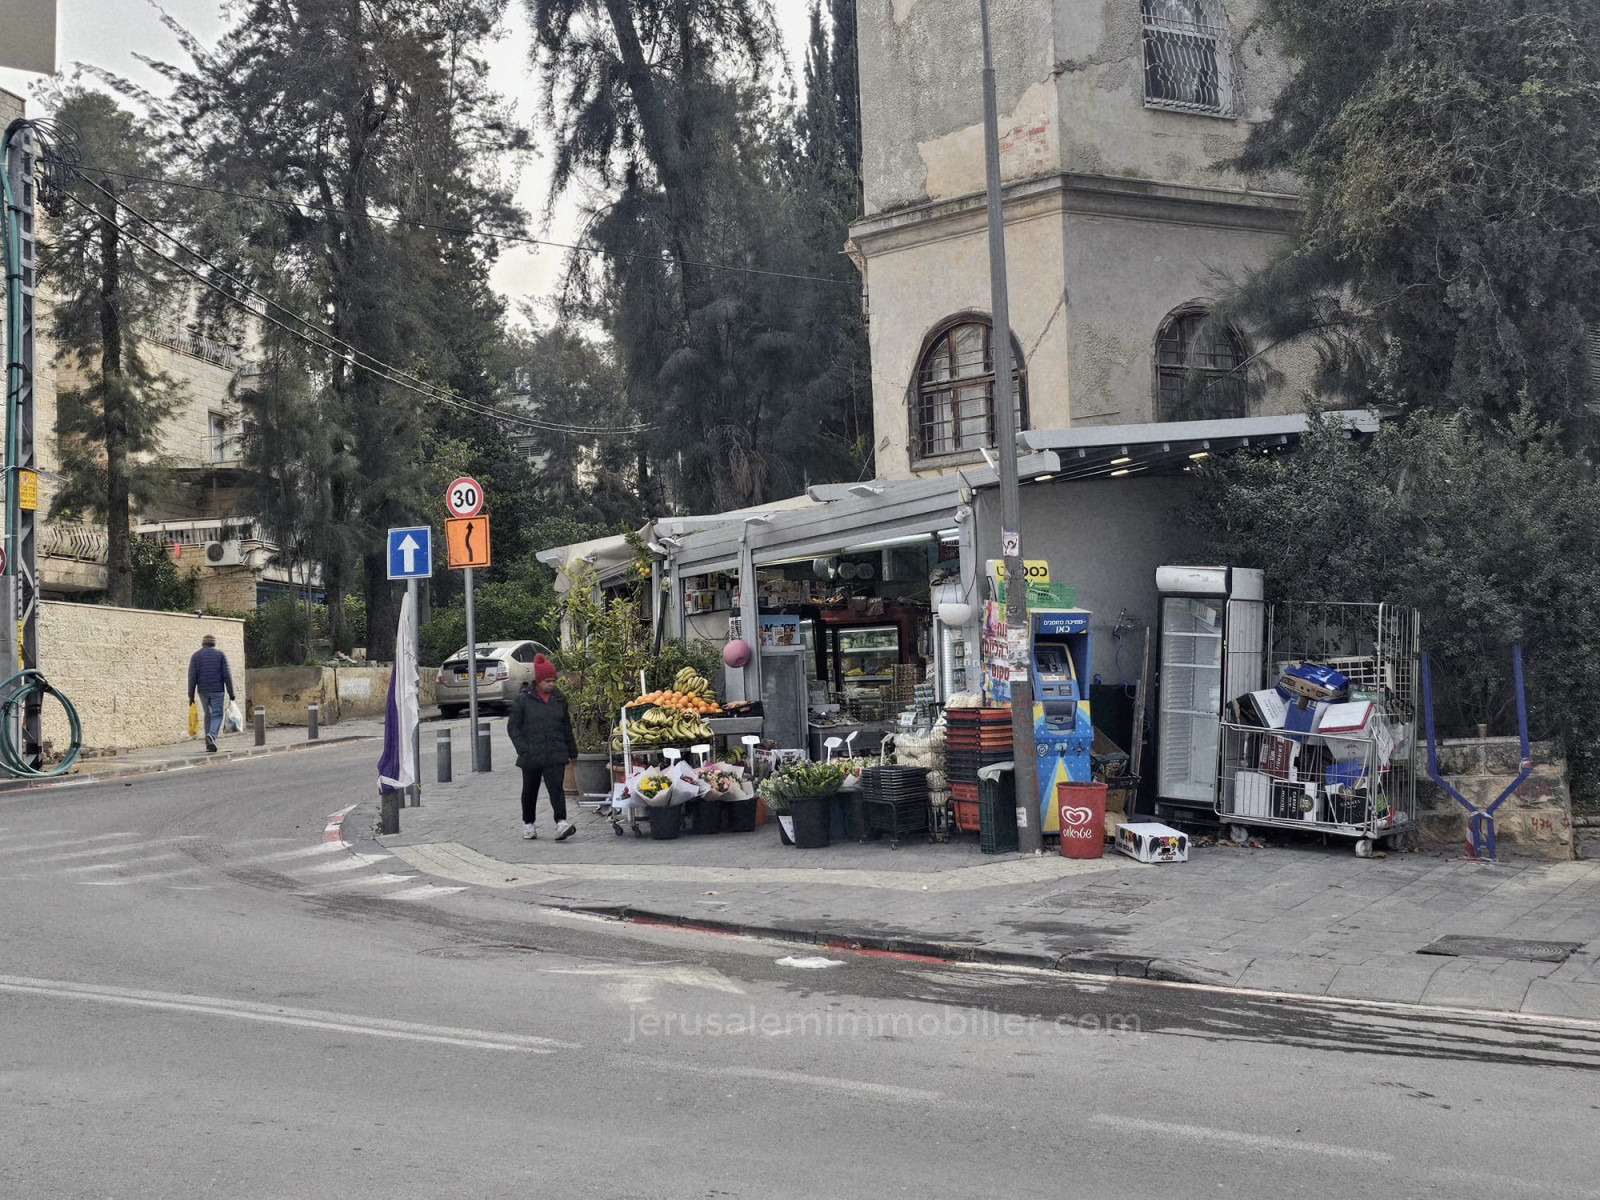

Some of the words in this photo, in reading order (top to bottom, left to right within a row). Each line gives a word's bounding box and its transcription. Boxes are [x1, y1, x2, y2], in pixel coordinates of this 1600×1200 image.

[453, 488, 476, 508] 30
[1055, 626, 1071, 634] כאן
[1062, 825, 1093, 839] שטראוס
